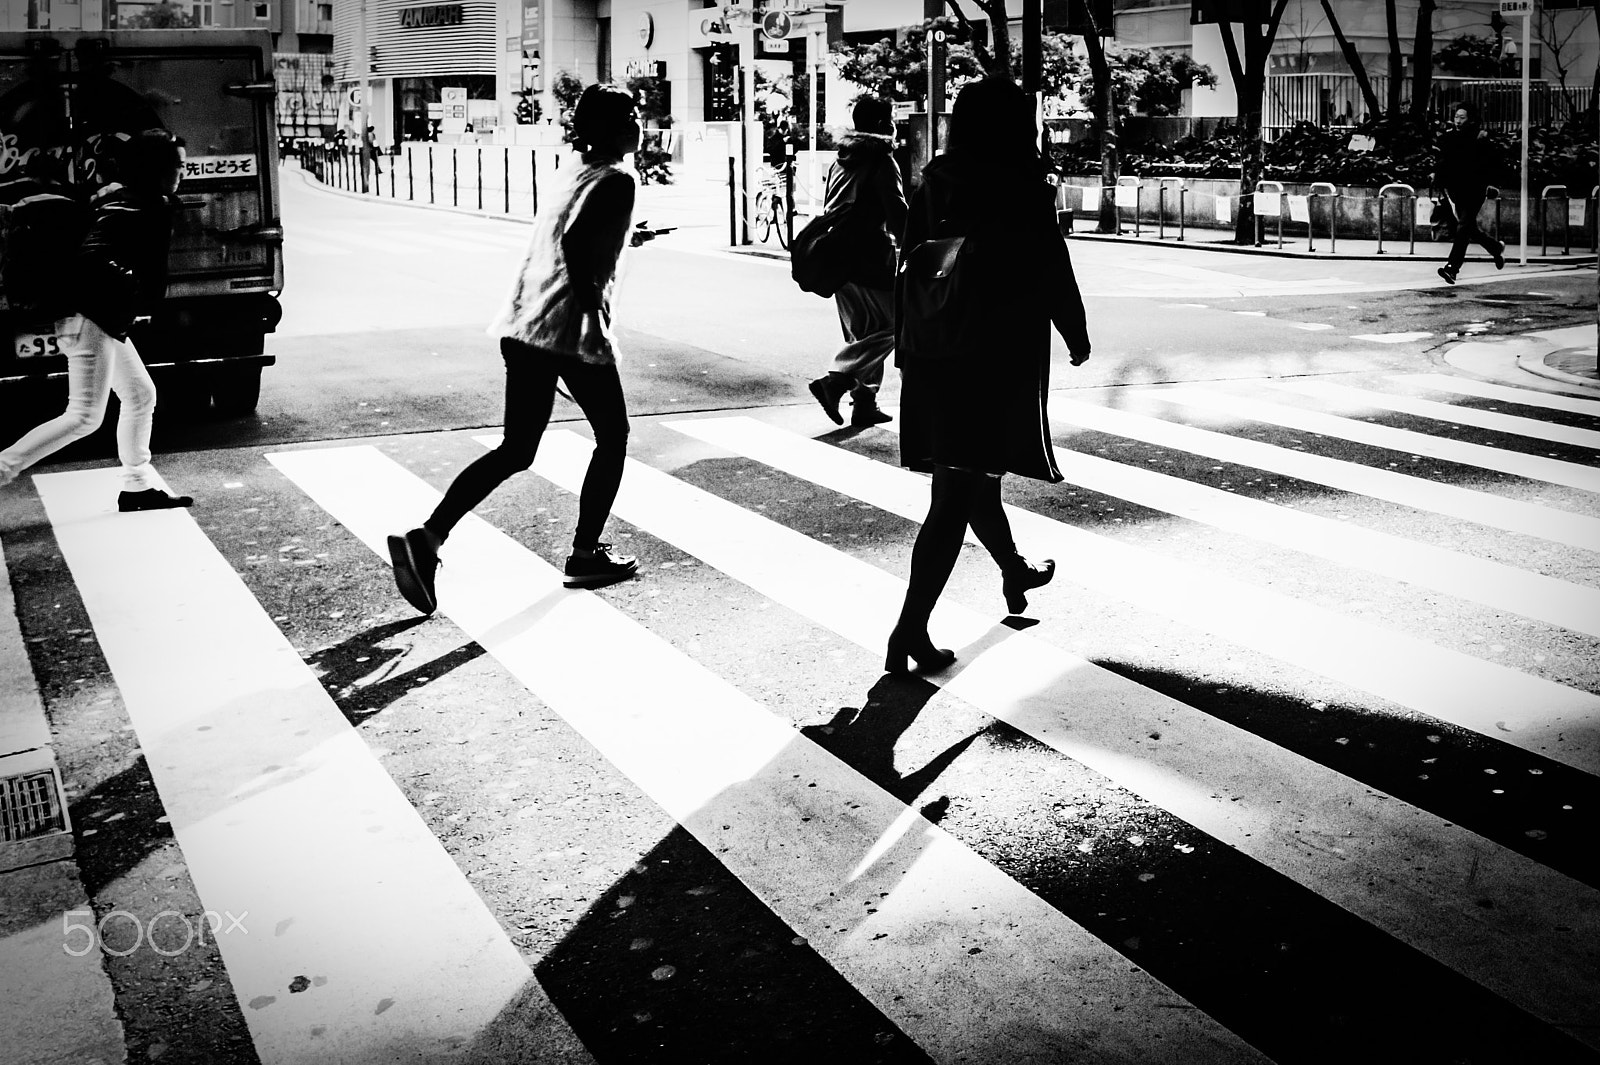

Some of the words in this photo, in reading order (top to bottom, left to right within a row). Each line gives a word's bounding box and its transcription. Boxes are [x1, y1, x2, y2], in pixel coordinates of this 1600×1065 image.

[181, 159, 252, 176] 先にどうぞ
